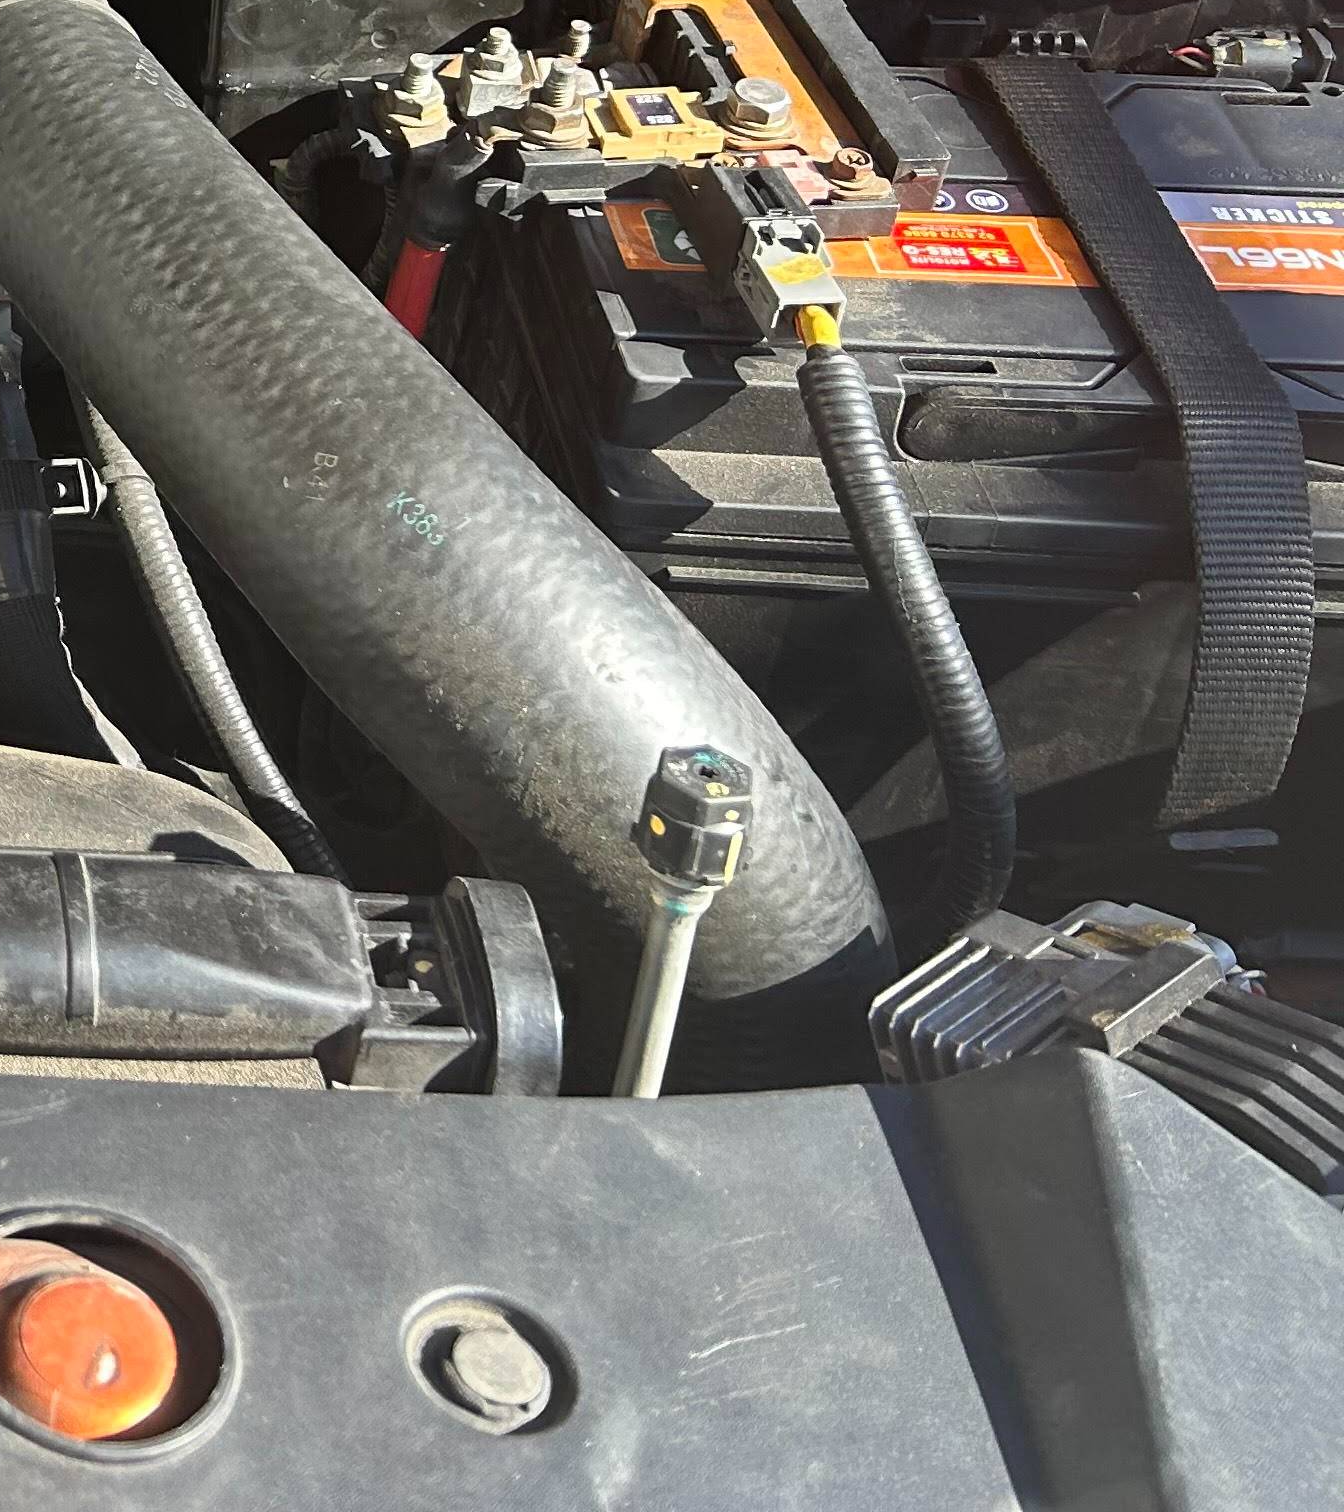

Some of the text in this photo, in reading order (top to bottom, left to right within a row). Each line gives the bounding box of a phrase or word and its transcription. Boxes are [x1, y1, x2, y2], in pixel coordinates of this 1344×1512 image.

[1210, 205, 1334, 226] STICKER
[902, 244, 967, 257] RES-Q
[1197, 245, 1344, 270] N66L
